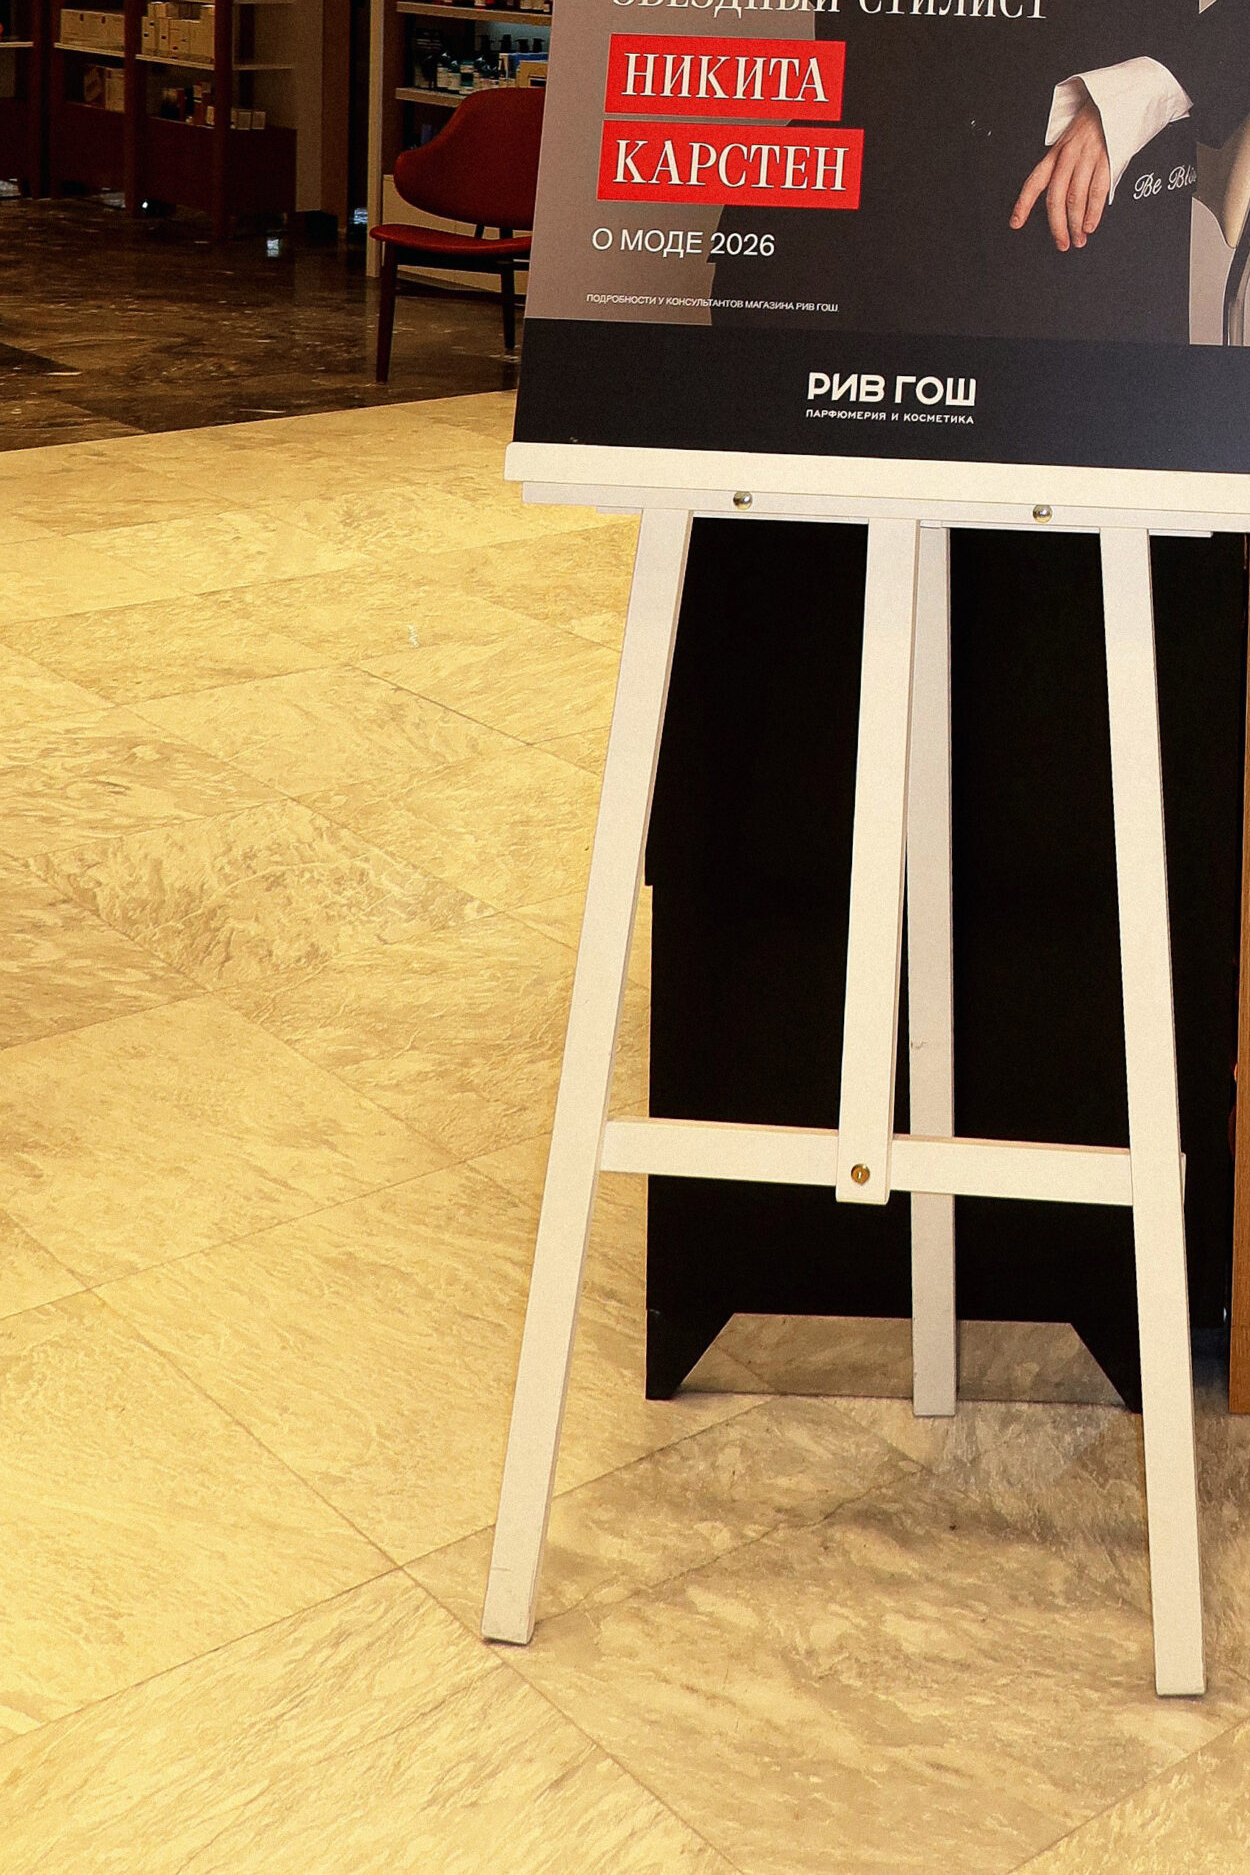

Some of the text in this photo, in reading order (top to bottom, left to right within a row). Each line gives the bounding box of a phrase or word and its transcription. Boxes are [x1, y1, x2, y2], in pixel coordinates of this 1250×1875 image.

[621, 52, 829, 102] НИКИТА
[612, 139, 849, 191] КАРСТЕН
[1133, 172, 1162, 200] Be
[591, 228, 775, 258] О МОДЕ 2026
[586, 294, 656, 305] ПОДРОБНОСТИ
[658, 296, 664, 305] У
[666, 297, 743, 309] КОНСУЛЬТАНТОВ
[745, 300, 794, 311] МАГАЗИНА
[795, 302, 815, 311] РИВ
[807, 372, 977, 406] РИВ ГОШ
[806, 409, 975, 424] ПАРФЮМЕРИЯ И КОСМЕТИКА
